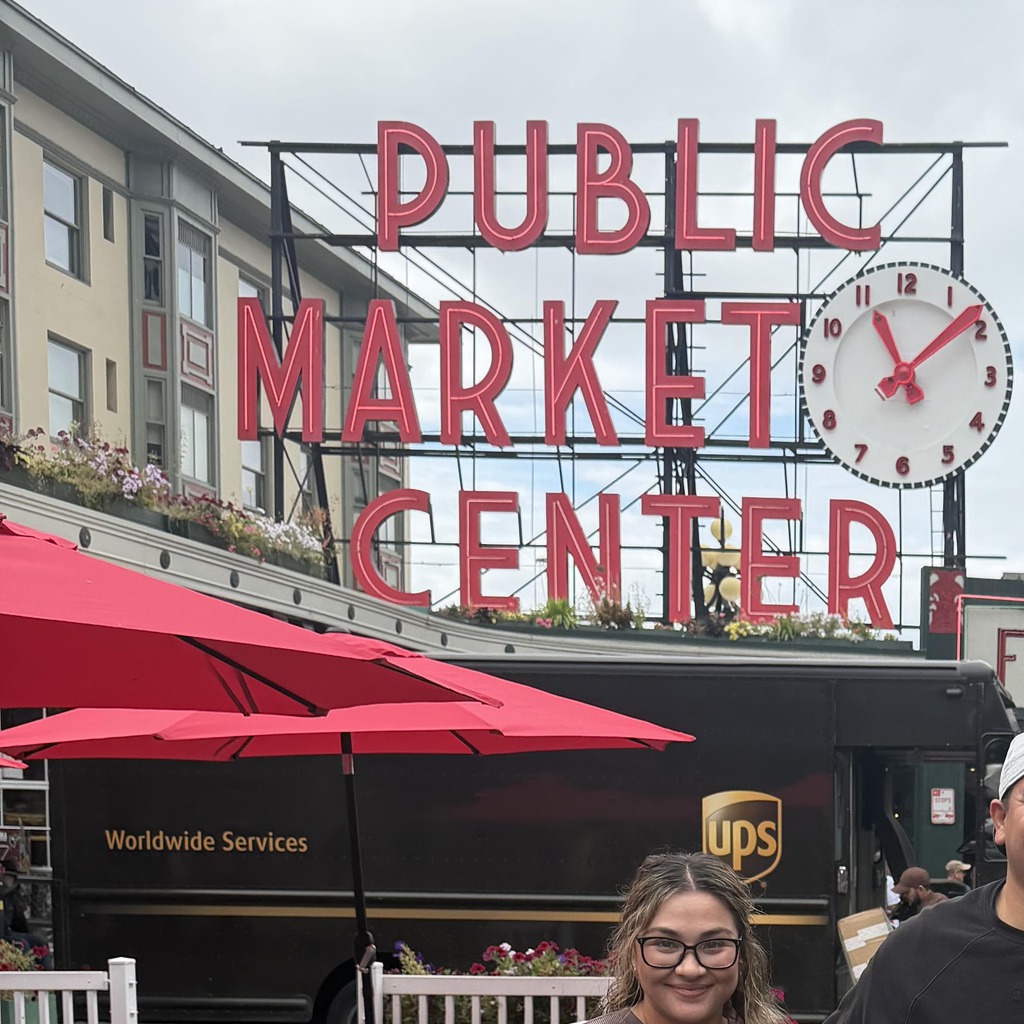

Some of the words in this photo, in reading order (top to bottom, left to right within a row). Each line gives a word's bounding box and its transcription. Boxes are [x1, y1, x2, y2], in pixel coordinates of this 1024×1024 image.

[378, 119, 885, 255] PUBLIC
[897, 273, 917, 294] 12
[856, 285, 870, 306] 11
[947, 286, 953, 307] 1
[824, 318, 842, 338] 10
[975, 320, 987, 340] 2
[238, 297, 801, 448] MARKET
[812, 364, 826, 384] 9
[984, 366, 997, 387] 3
[823, 409, 837, 430] 8
[969, 411, 985, 432] 4
[854, 444, 868, 463] 7
[941, 445, 955, 464] 5
[895, 456, 910, 475] 6
[350, 489, 897, 630] CENTER
[105, 829, 215, 851] Worldwide
[222, 831, 308, 853] Services
[708, 820, 777, 871] ups
